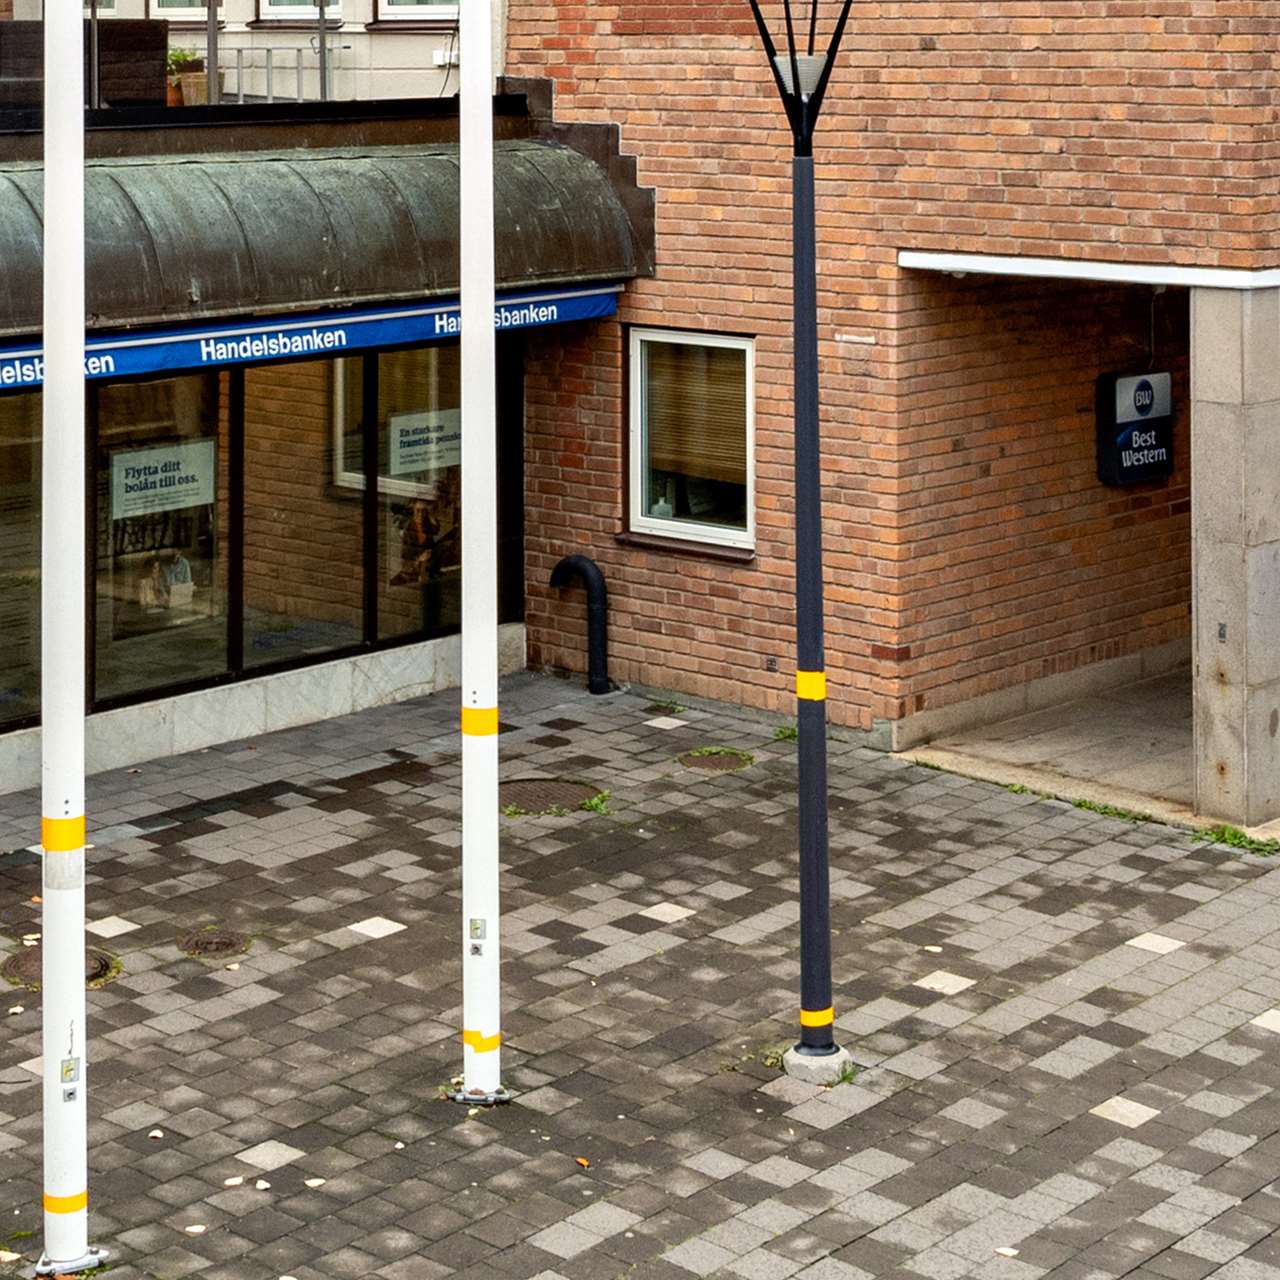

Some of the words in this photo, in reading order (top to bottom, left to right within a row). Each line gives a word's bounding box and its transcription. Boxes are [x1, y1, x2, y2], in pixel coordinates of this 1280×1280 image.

[200, 327, 347, 362] Handelsbanken
[1135, 389, 1152, 407] BW
[1132, 429, 1157, 448] Best
[1121, 447, 1167, 468] Western
[124, 464, 159, 480] Flytta
[160, 460, 182, 473] ditt
[124, 478, 158, 494] bolån
[159, 475, 177, 489] till
[177, 473, 199, 486] oss.
